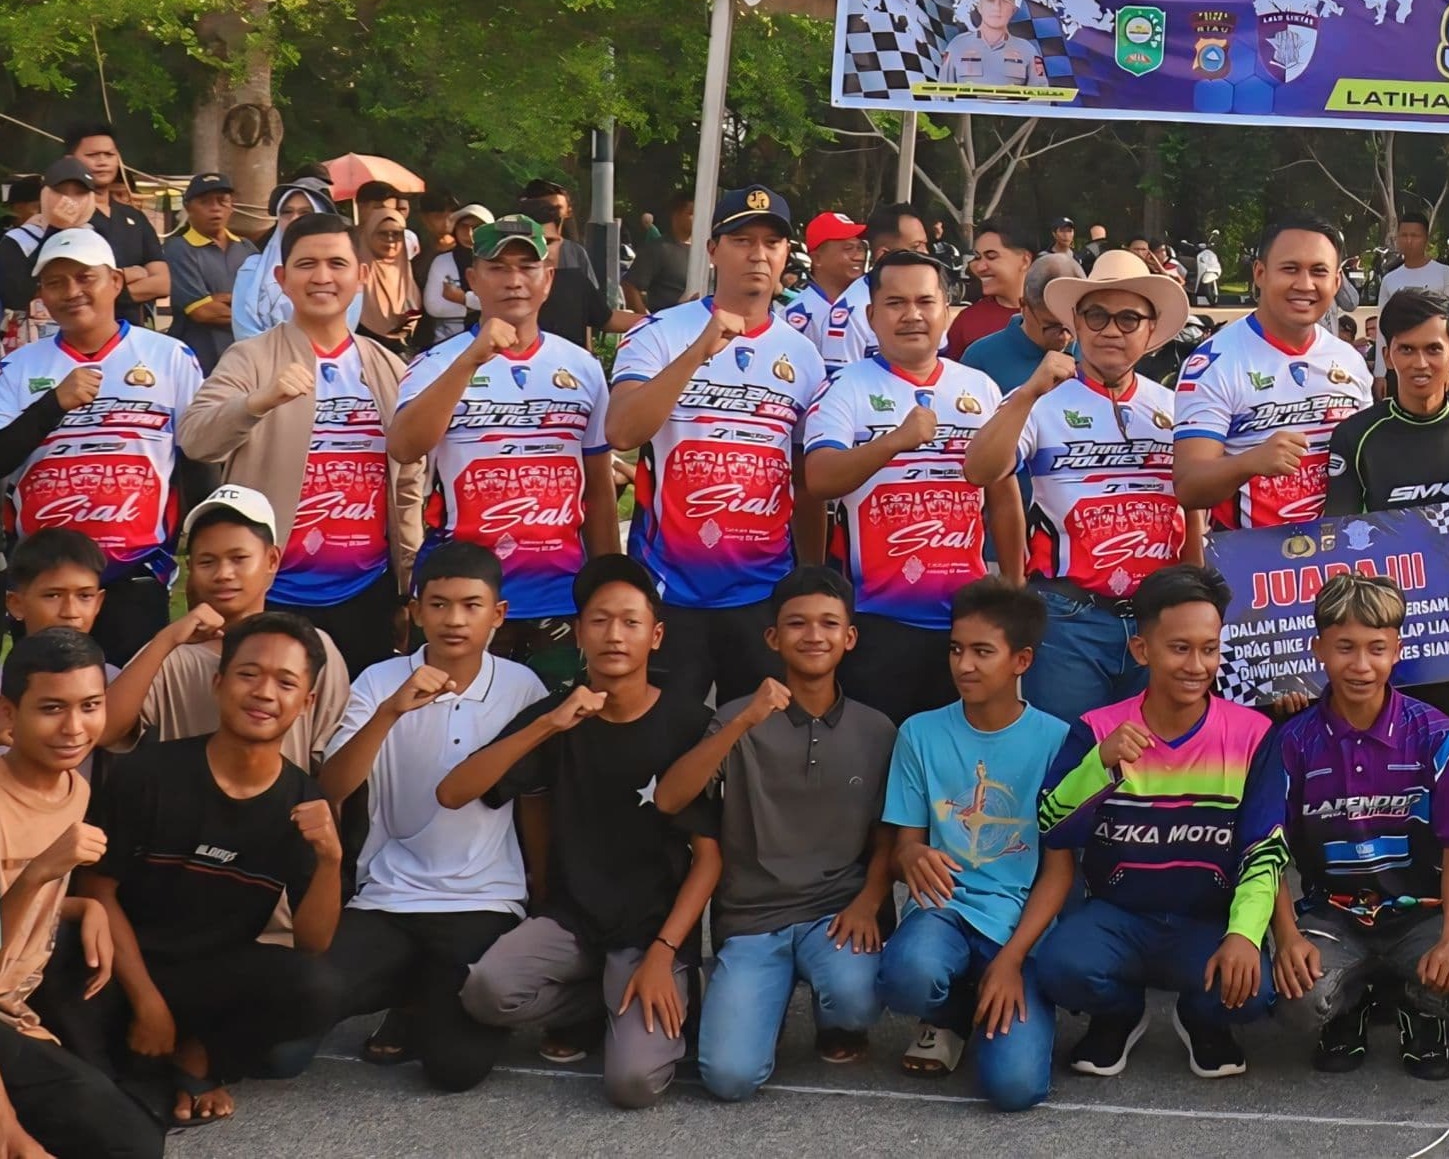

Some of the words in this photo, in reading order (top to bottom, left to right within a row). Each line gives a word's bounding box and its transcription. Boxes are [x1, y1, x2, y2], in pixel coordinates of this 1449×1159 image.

[35, 492, 140, 528] Siak
[479, 494, 574, 533] Siak
[686, 484, 781, 518] Siak
[887, 519, 976, 556] Siak
[1230, 620, 1276, 638] DALAM
[1279, 615, 1316, 632] RANG
[1234, 641, 1271, 659] DRAG
[1274, 639, 1304, 655] BIKE
[1400, 622, 1425, 638] LAP
[1095, 822, 1159, 844] AZKA
[1167, 825, 1230, 845] MOTO
